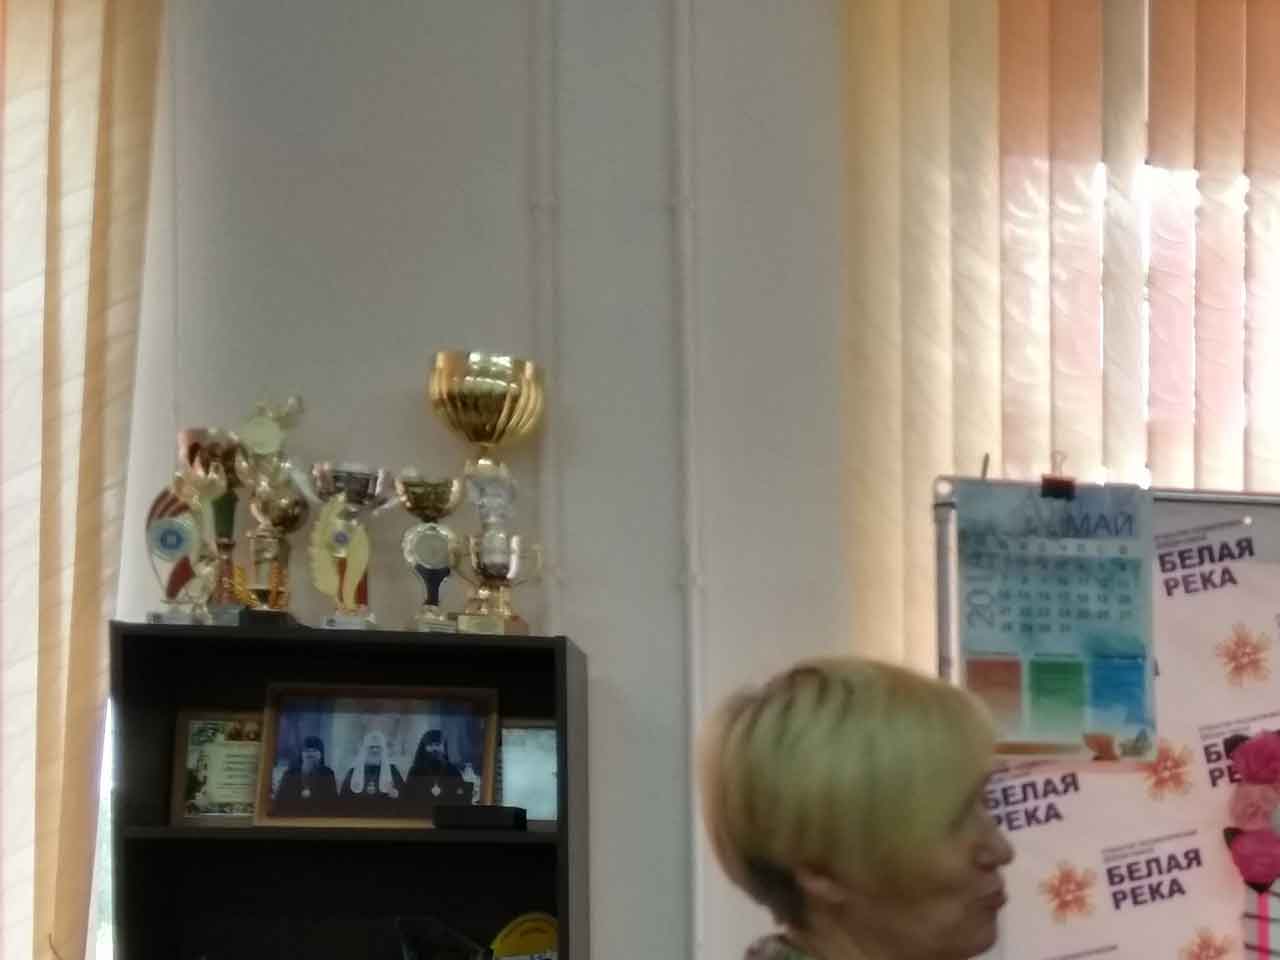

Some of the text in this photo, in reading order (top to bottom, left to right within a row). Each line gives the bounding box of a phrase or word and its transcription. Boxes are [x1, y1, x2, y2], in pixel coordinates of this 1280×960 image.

[1158, 536, 1254, 573] БЕЛАЯ
[1164, 567, 1238, 597] РЕКА
[1106, 847, 1203, 887] БЕЛАЯ
[1112, 877, 1186, 910] РЕКА
